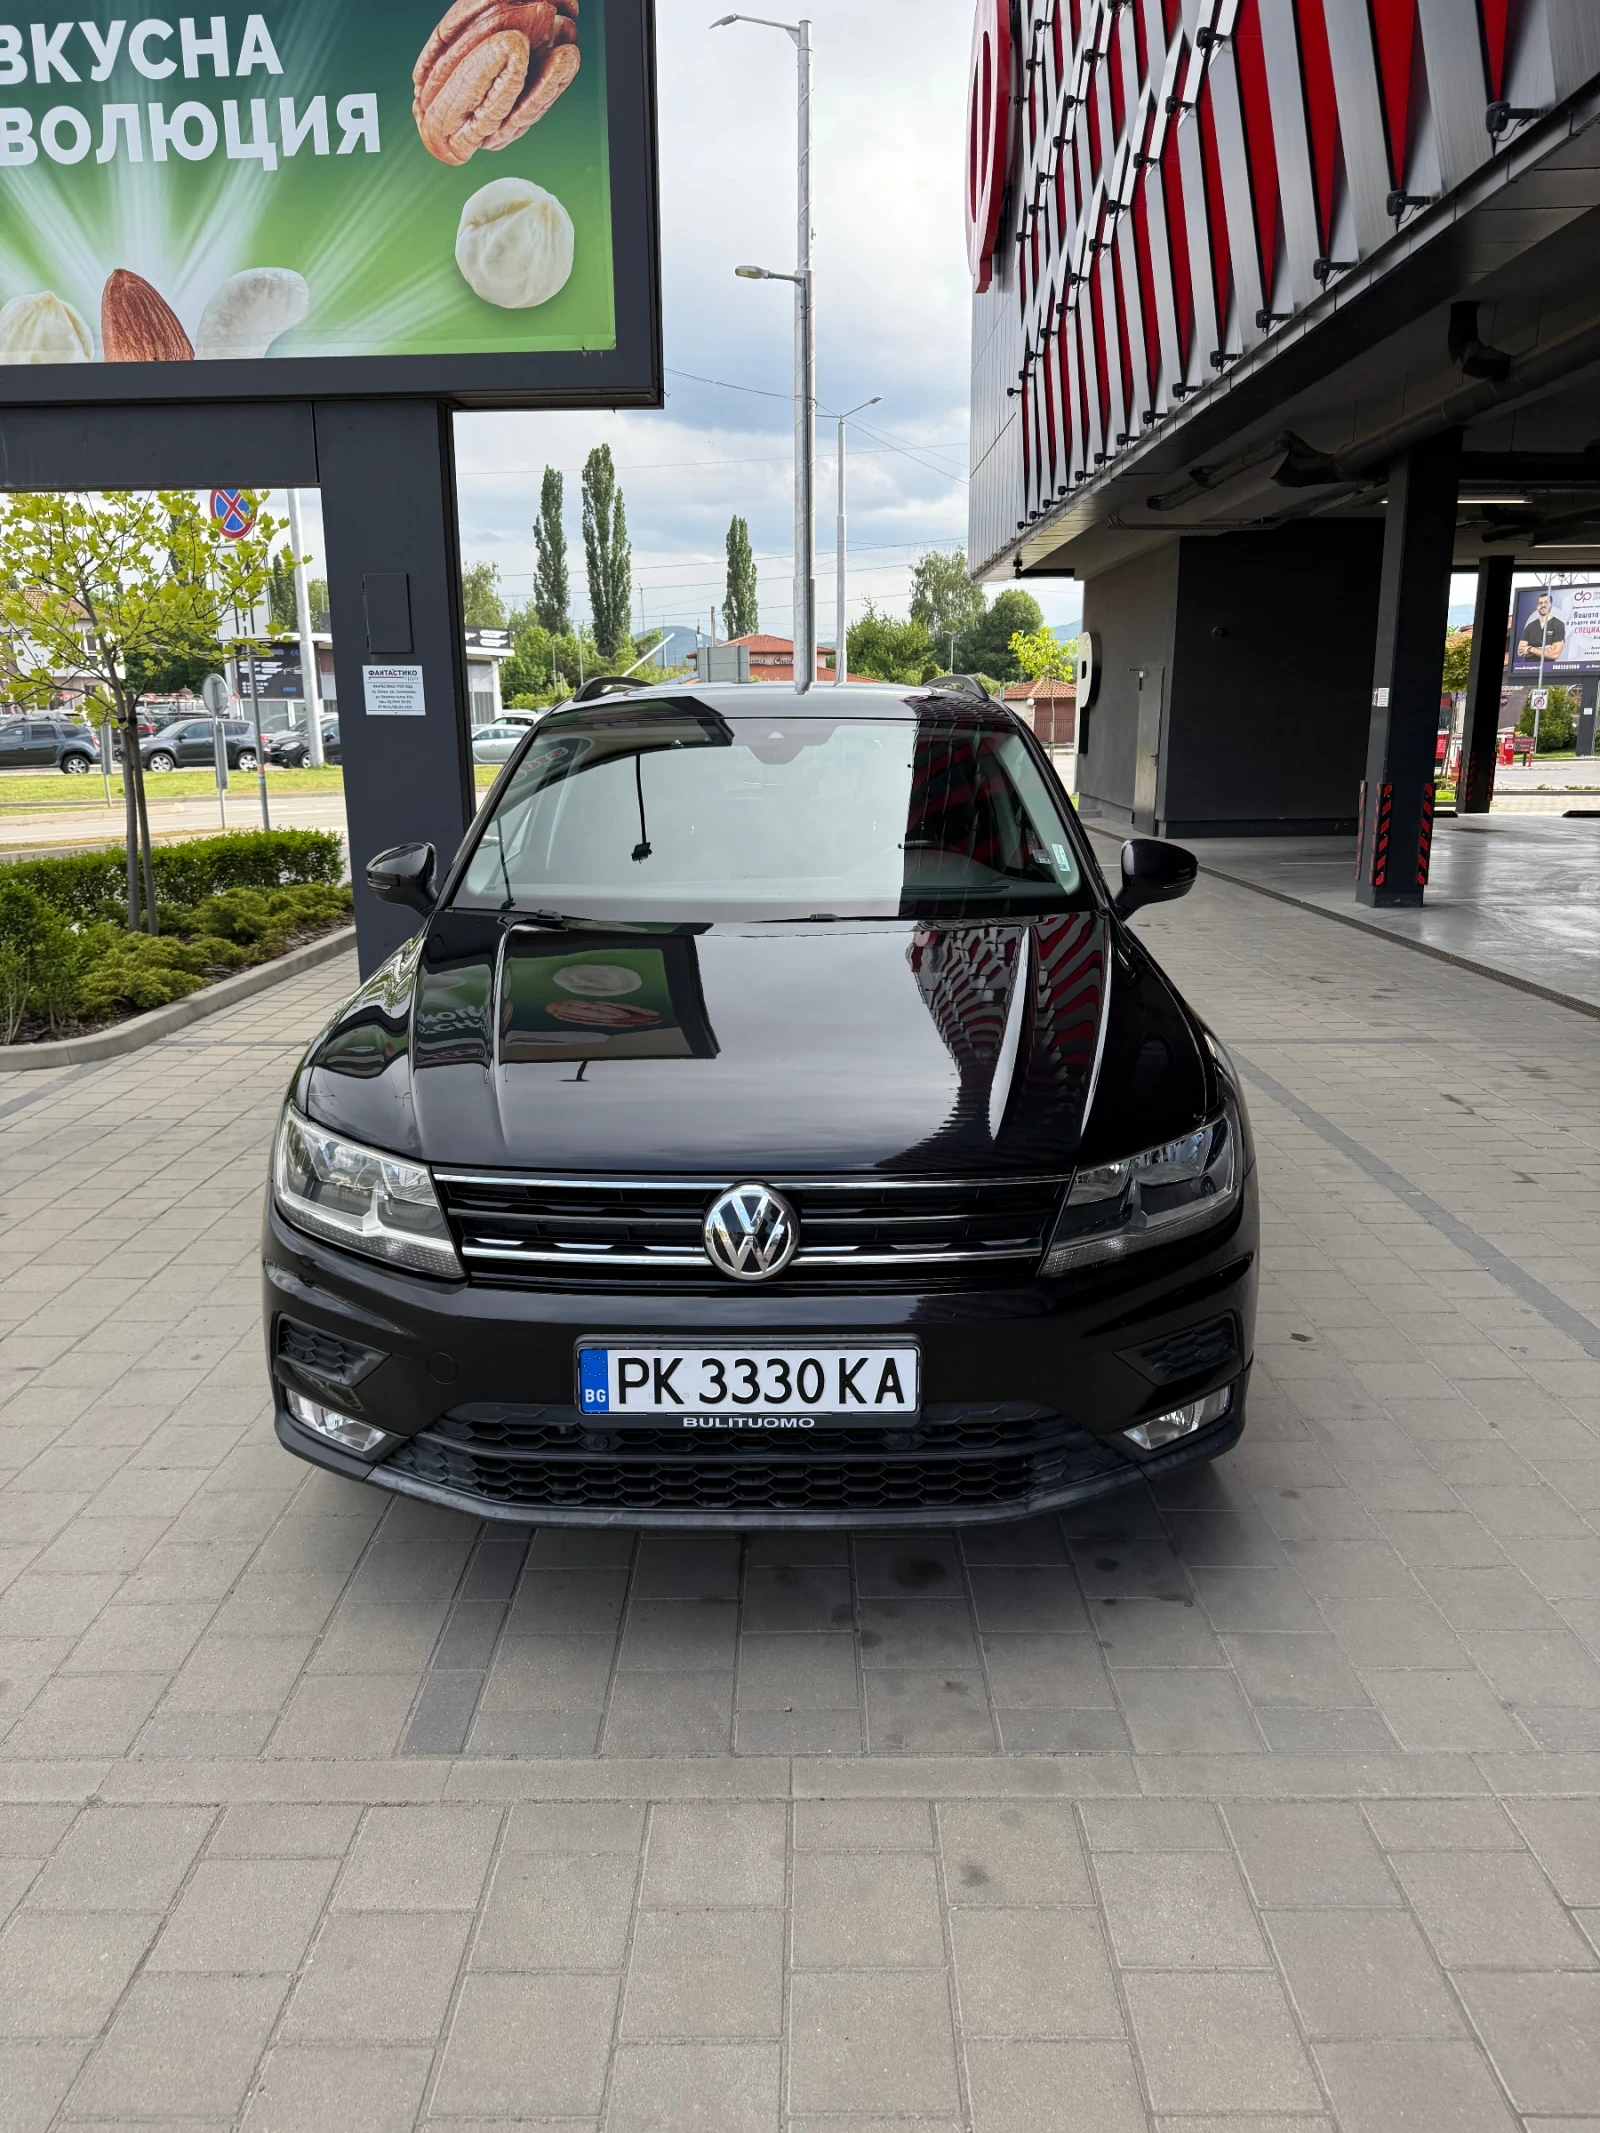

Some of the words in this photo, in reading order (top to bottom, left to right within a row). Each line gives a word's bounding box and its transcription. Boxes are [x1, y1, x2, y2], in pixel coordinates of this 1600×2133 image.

[0, 14, 284, 85] ВКУСНА
[0, 93, 381, 171] ВОЛЮЦИЯ
[1574, 626, 1600, 634] СПЕЦИА
[584, 1388, 607, 1403] BG
[618, 1357, 685, 1405] PK
[699, 1357, 825, 1405] 3330
[838, 1357, 905, 1405] KA
[683, 1417, 815, 1428] BULITUOMO
